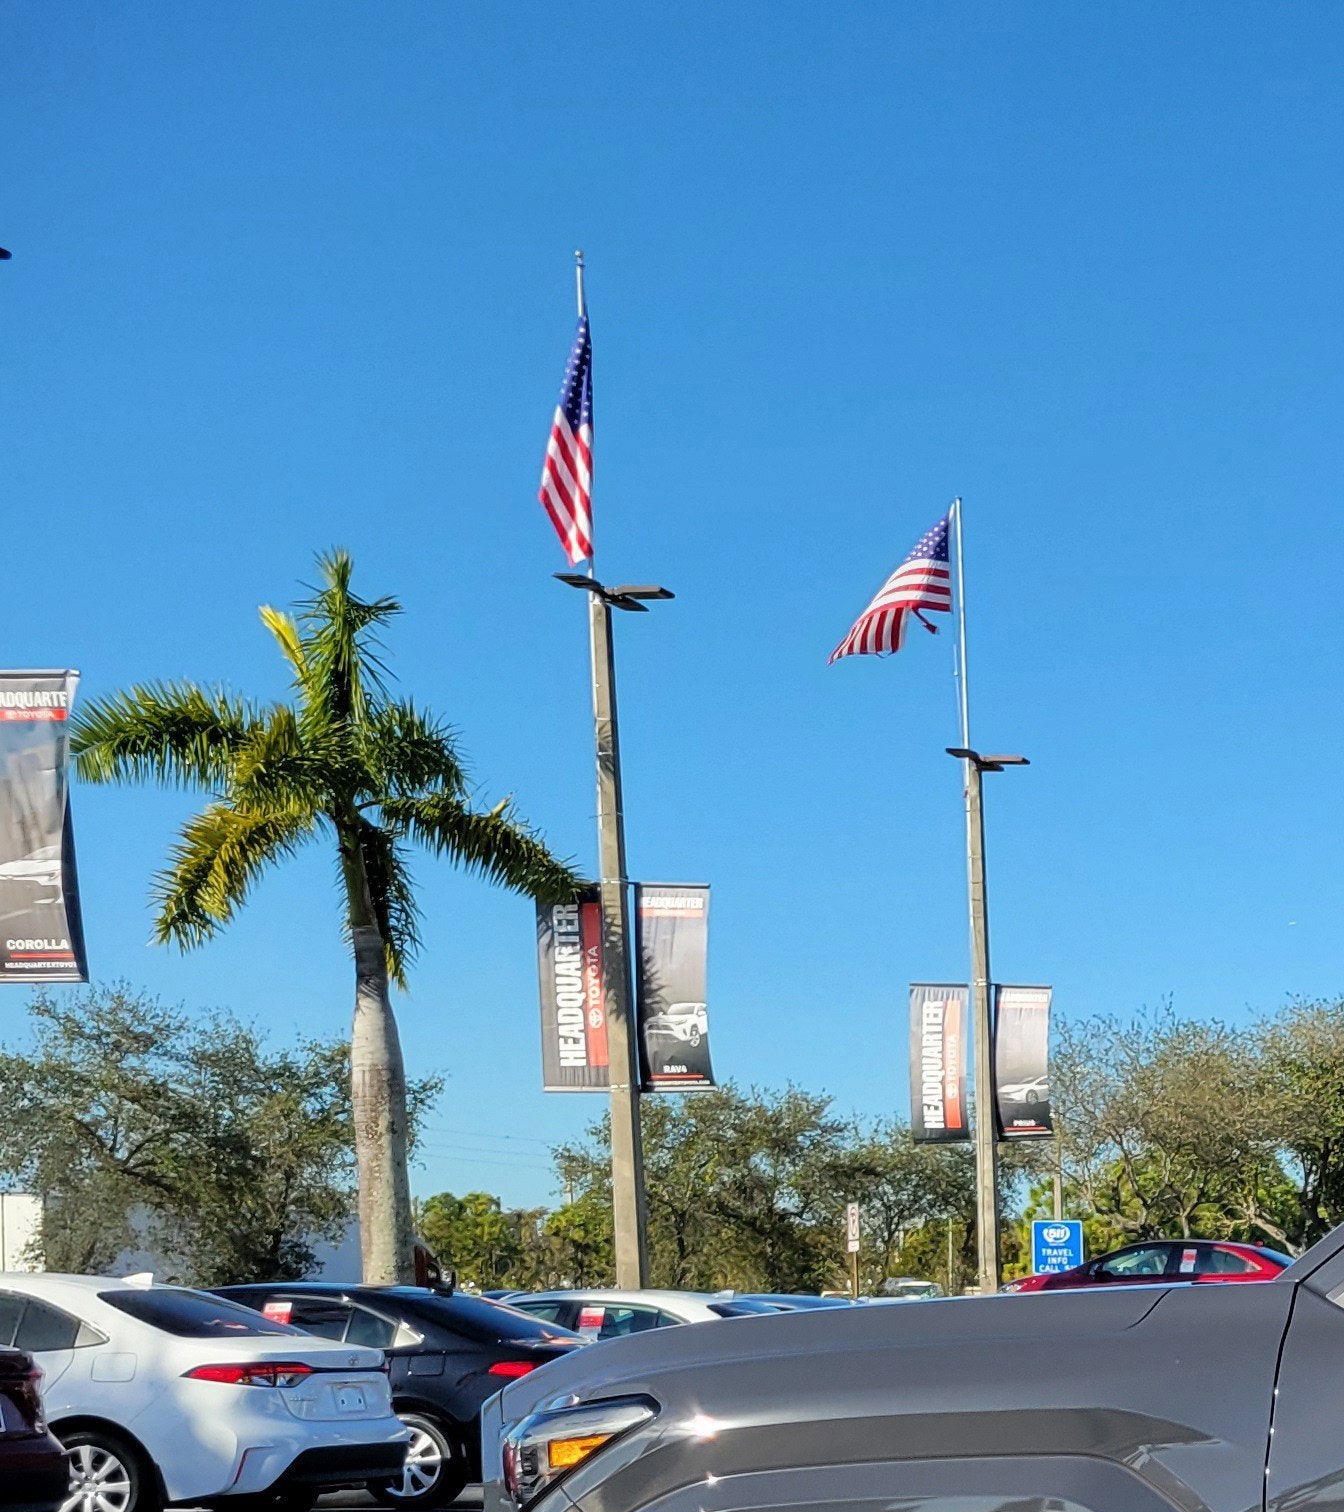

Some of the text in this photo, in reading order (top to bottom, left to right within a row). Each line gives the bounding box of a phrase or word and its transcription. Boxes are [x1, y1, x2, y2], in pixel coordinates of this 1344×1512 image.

[6, 939, 70, 950] COROLLA
[586, 945, 602, 1006] TOYOTA
[553, 904, 587, 1067] HEADQUARTER
[922, 1000, 946, 1129] HEADQUARTER
[1041, 1247, 1074, 1257] TRAVEL
[1047, 1256, 1068, 1265] INFO
[1038, 1264, 1061, 1273] CALL
